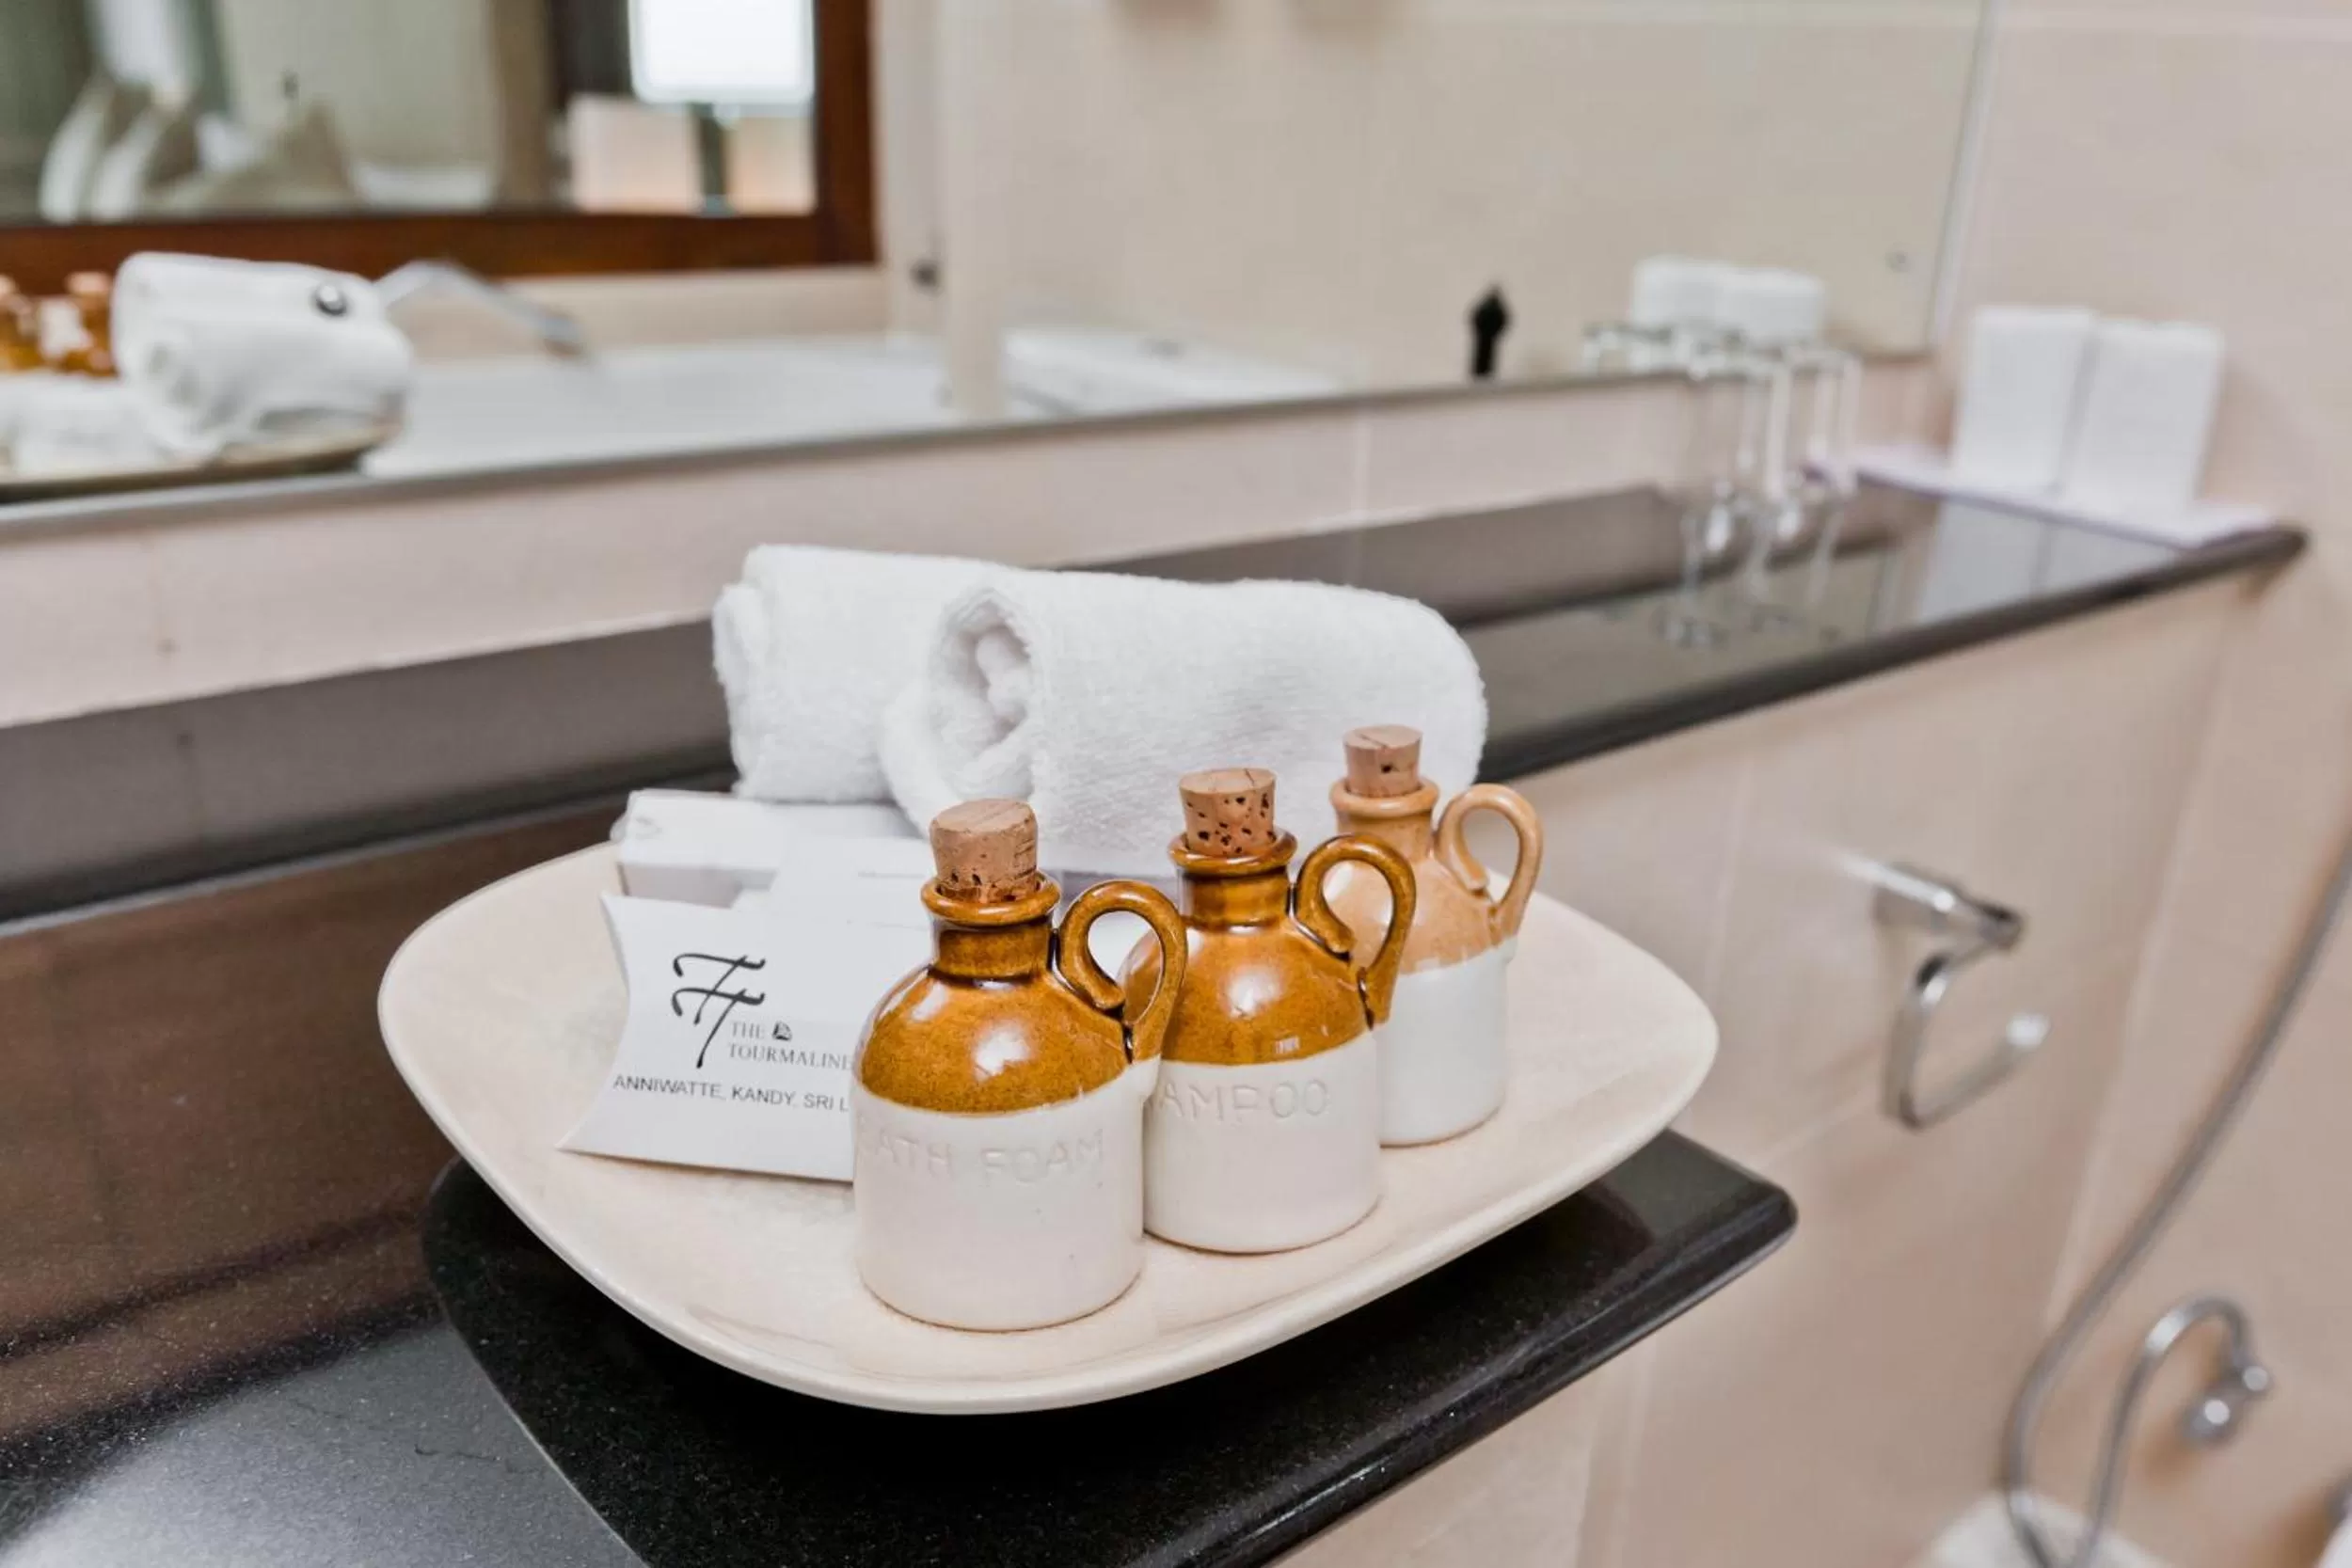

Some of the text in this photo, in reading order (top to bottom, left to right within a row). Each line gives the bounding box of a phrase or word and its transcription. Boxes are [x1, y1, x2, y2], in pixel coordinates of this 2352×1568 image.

[730, 1020, 765, 1039] THE
[727, 1042, 852, 1070] TOURMALINE
[803, 1093, 834, 1111] SRI
[1158, 1077, 1331, 1130] AMPOO
[860, 1126, 1104, 1188] ATH FOAM
